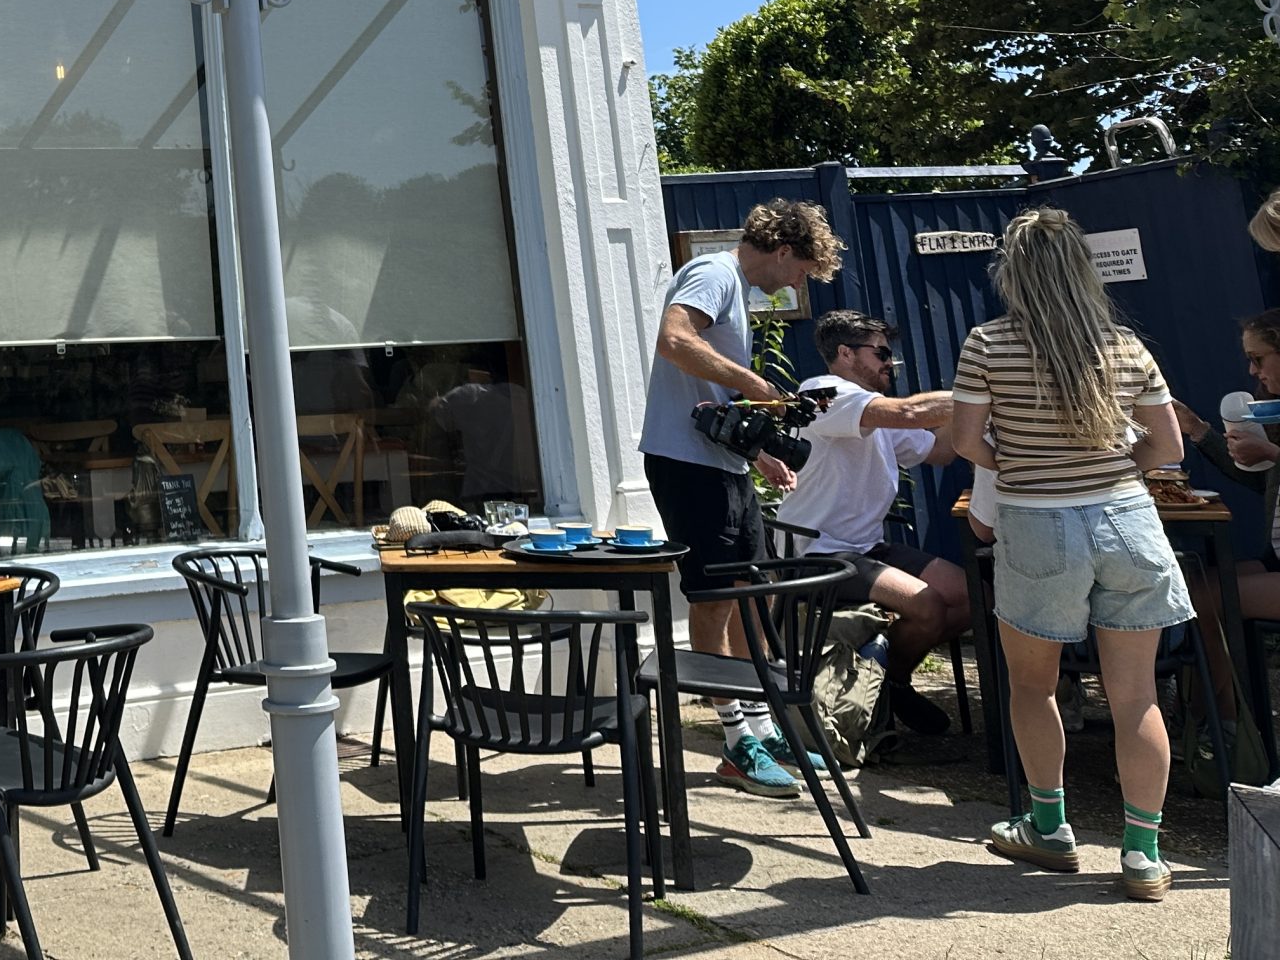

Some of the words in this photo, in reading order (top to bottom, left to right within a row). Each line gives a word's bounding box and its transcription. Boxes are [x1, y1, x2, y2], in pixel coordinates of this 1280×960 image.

[919, 236, 947, 251] FLAT
[962, 235, 995, 249] ENTRY
[1121, 248, 1138, 256] GATE
[1096, 259, 1124, 268] REQUIRED
[1113, 268, 1131, 276] TIMES
